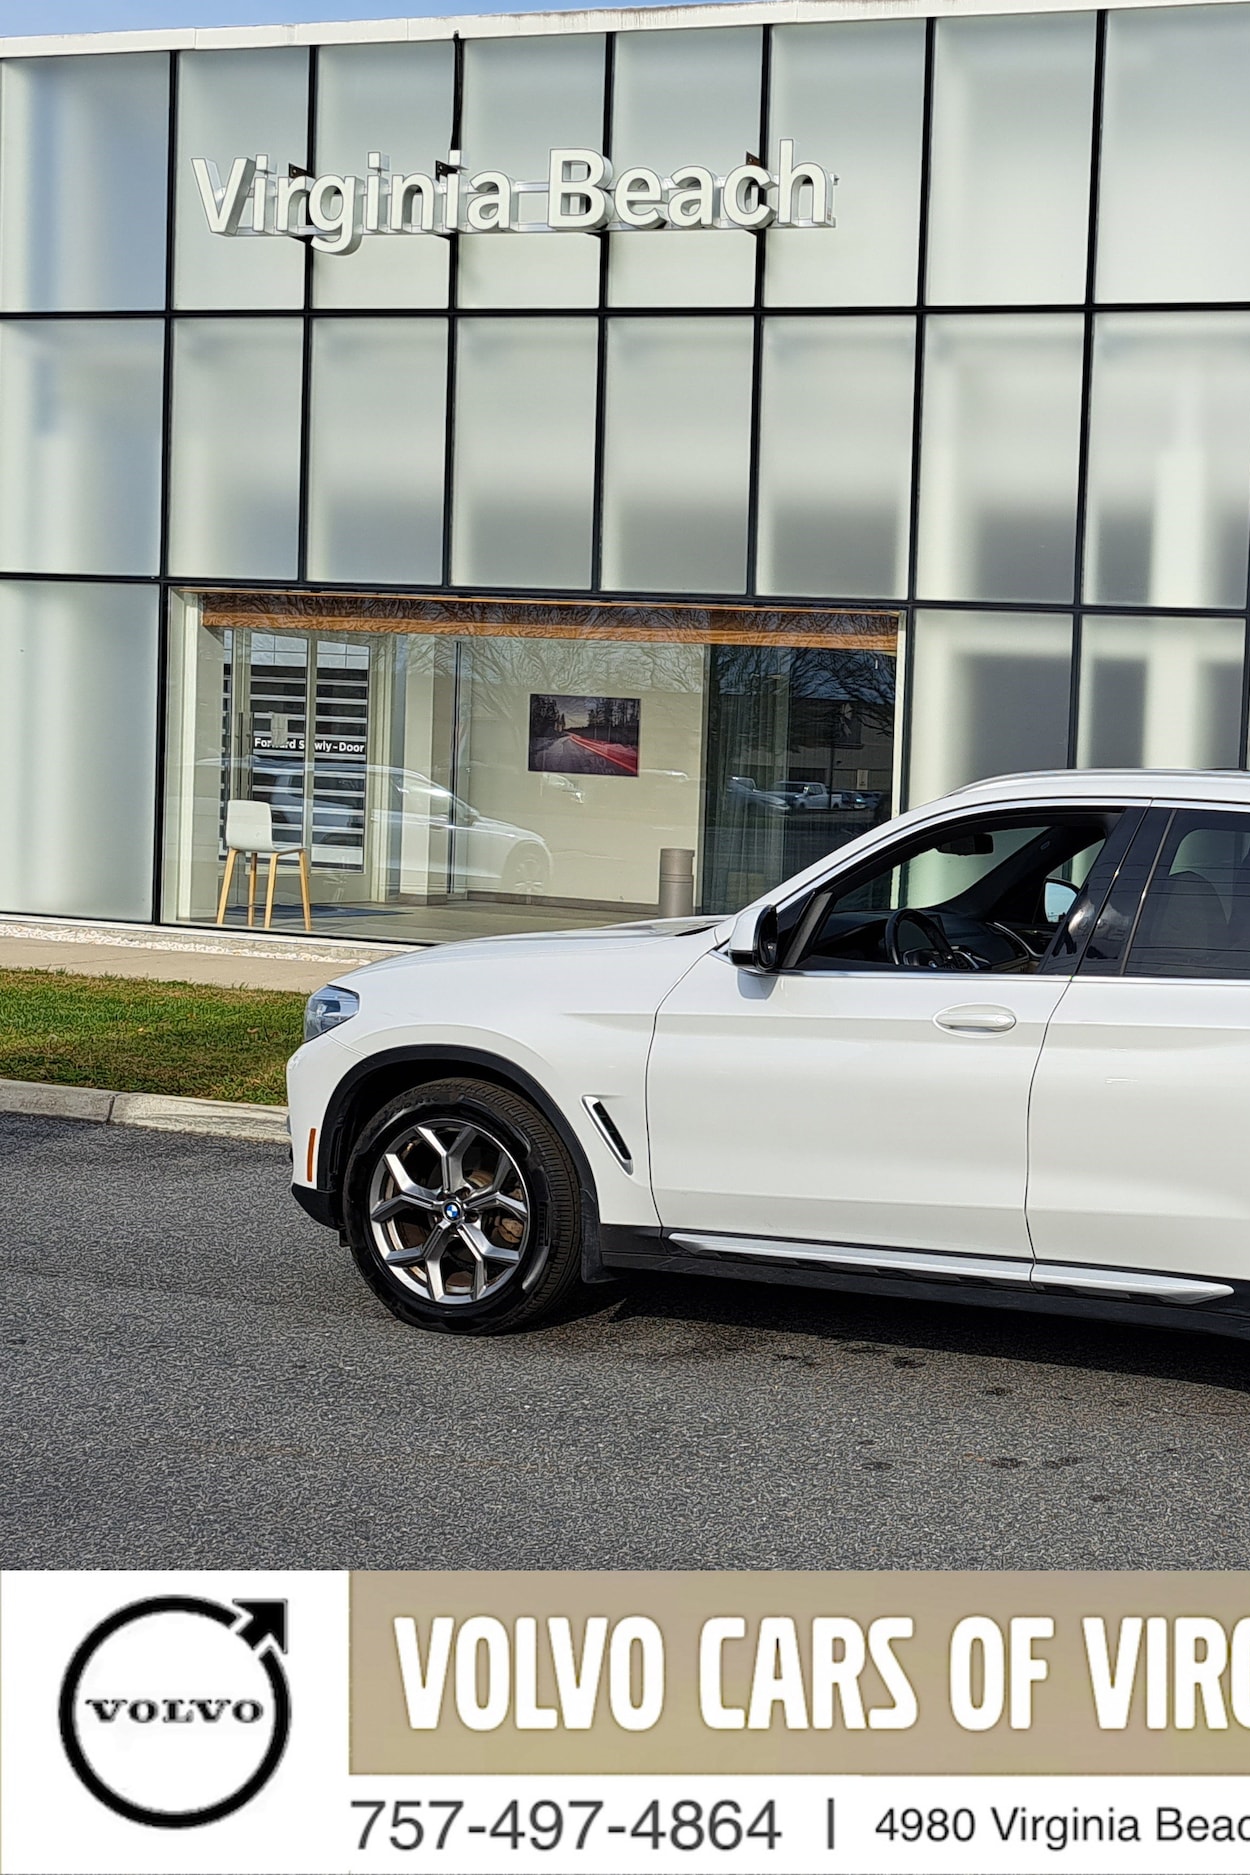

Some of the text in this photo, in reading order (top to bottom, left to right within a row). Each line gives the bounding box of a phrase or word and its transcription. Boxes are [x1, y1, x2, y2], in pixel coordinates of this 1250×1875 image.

[191, 139, 832, 254] Virginia Beach
[298, 741, 365, 752] Swly-Door
